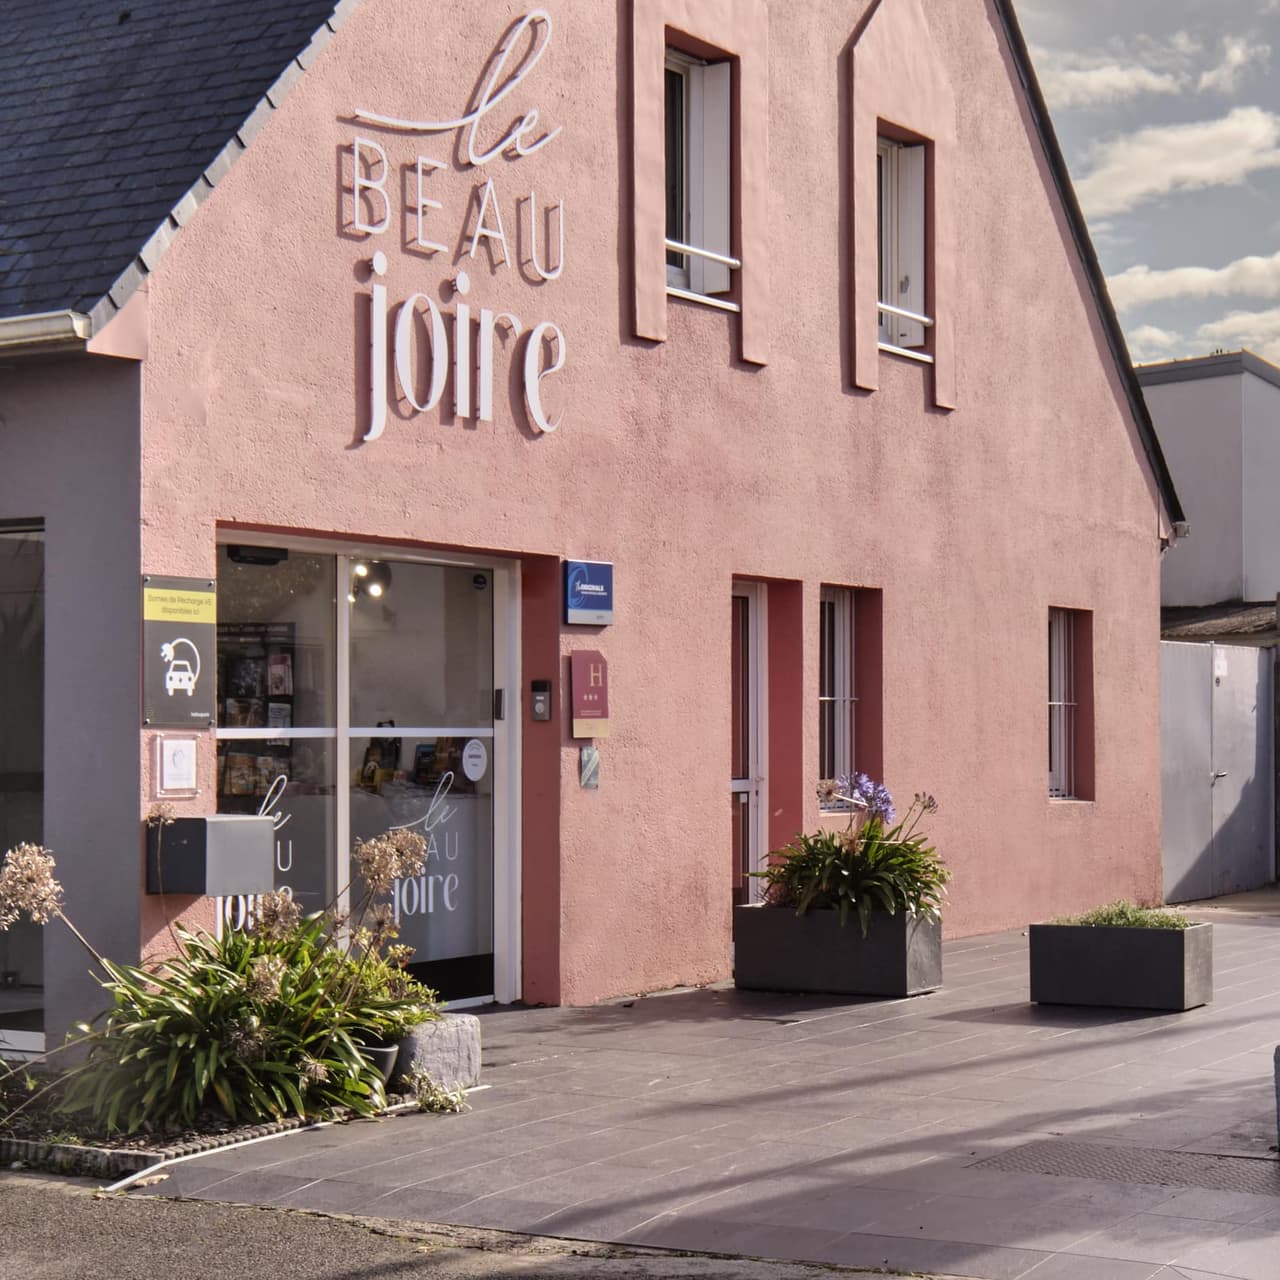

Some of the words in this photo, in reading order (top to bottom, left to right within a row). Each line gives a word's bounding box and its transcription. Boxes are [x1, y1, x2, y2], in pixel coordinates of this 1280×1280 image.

[354, 8, 563, 167] le
[353, 136, 565, 281] BEAU
[363, 249, 567, 442] joire
[589, 663, 603, 687] H
[388, 771, 458, 831] le
